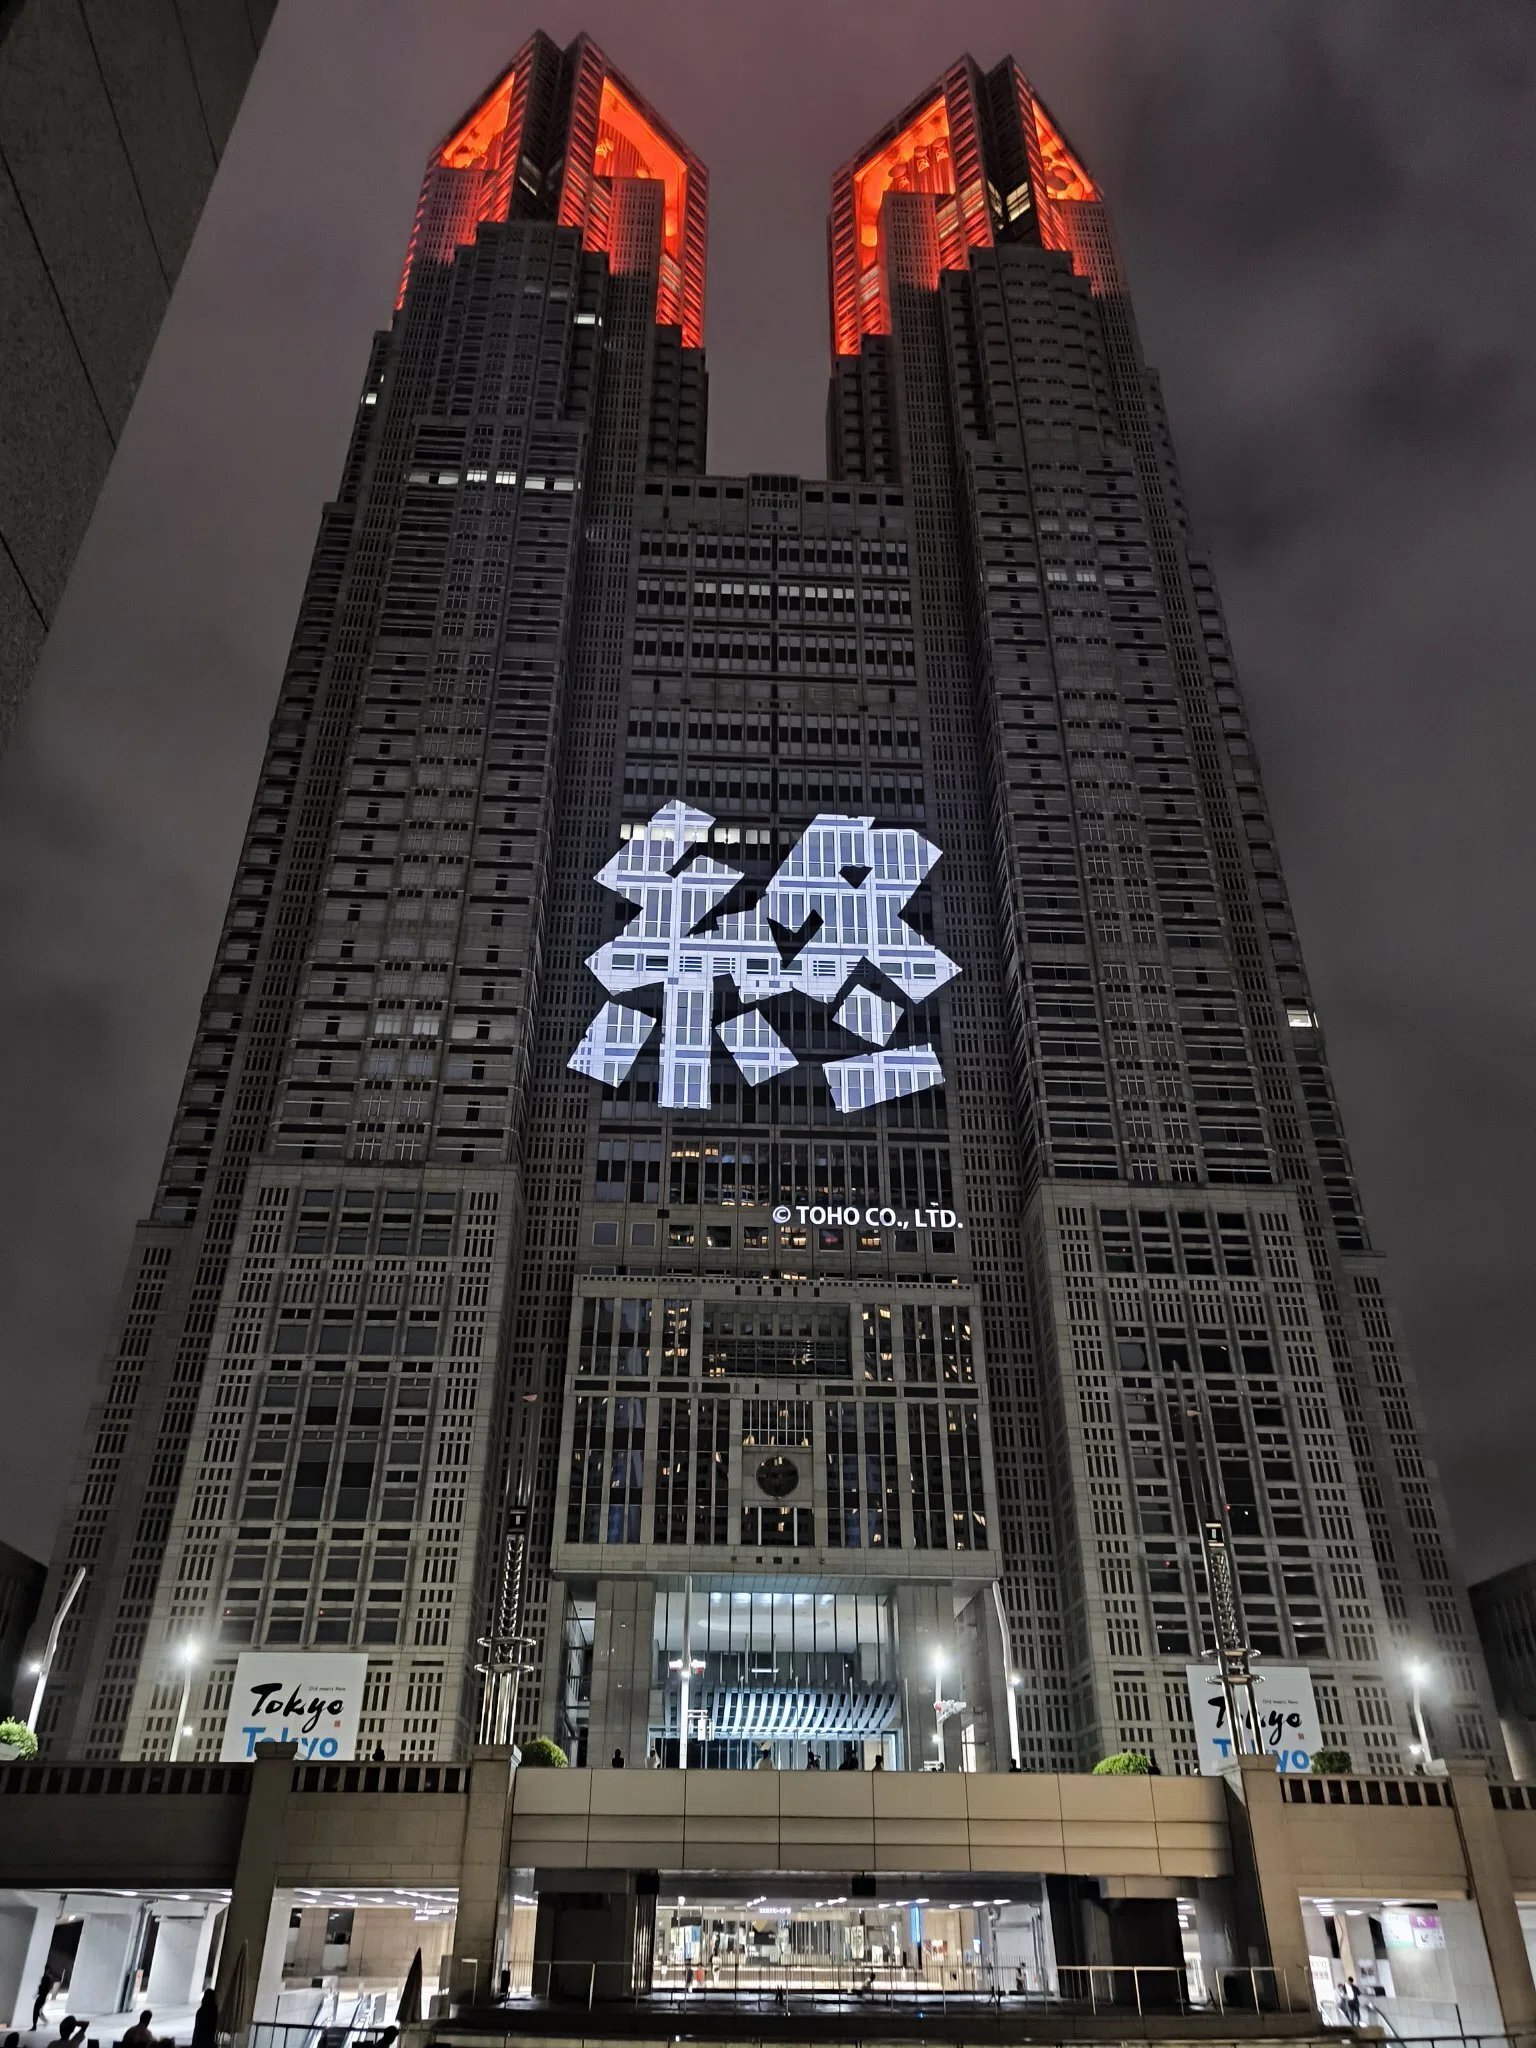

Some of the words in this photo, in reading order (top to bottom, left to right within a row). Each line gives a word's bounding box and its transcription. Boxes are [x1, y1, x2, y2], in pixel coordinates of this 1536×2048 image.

[567, 799, 963, 1113] 終
[795, 1205, 860, 1225] TOHO
[865, 1207, 909, 1230] CO.,
[914, 1208, 964, 1229] LTD.
[250, 1682, 344, 1734] Tokyo
[1208, 1696, 1302, 1746] Tyo
[1212, 1738, 1310, 1774] Tyo
